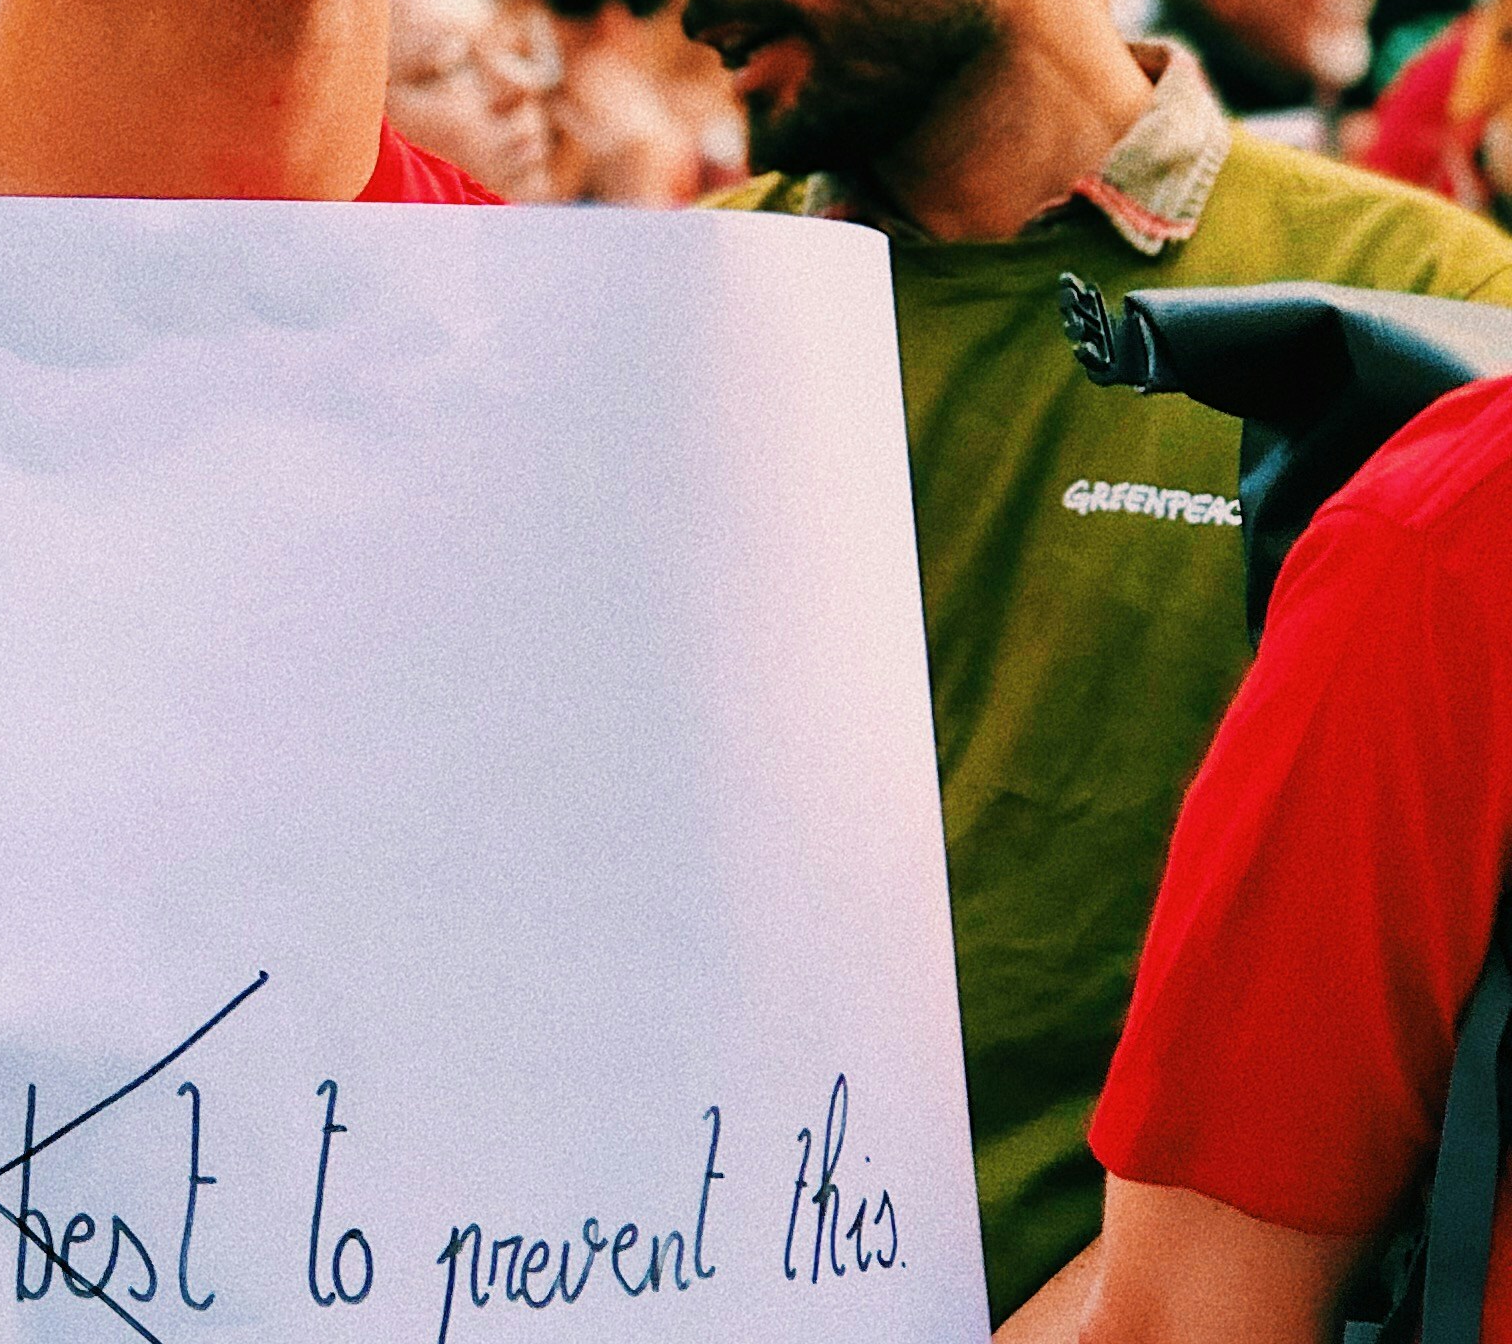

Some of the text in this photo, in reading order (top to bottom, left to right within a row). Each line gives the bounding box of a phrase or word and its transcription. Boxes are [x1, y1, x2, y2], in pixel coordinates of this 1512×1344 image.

[14, 1080, 218, 1313] best
[306, 1078, 376, 1309] to
[782, 1072, 910, 1285] this.
